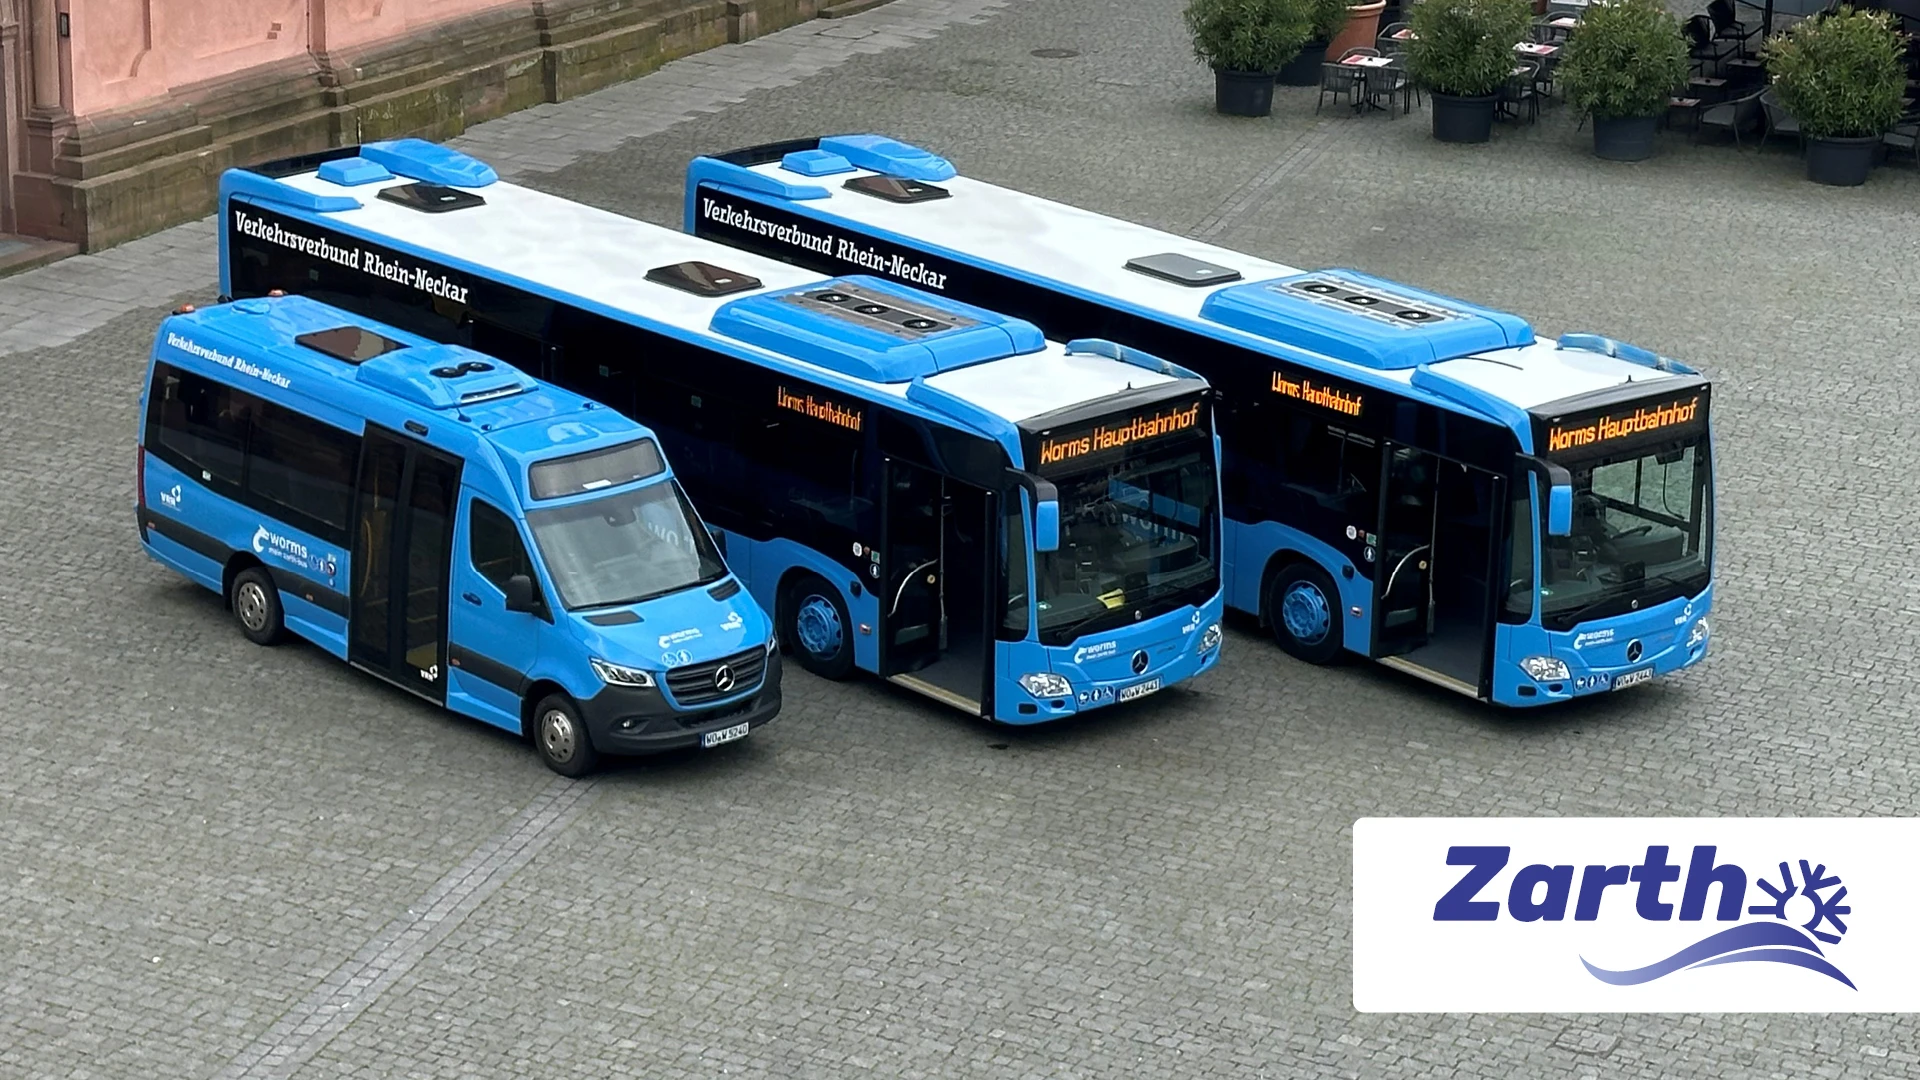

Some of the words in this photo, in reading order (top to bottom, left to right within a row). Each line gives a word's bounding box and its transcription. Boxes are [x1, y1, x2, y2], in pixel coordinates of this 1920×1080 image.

[235, 210, 359, 269] Verkehrsverbund
[364, 251, 468, 304] Rhein-Neckar
[703, 198, 832, 255] Verkehrsverbund
[836, 238, 947, 290] Rhein-Neckar
[167, 332, 235, 368] Verkehrsverbund
[234, 357, 291, 389] Rhein-Neckar
[1040, 436, 1089, 465] Worms
[1093, 402, 1200, 451] Hauptbahnhof
[1549, 426, 1595, 451] Worms
[1598, 396, 1698, 440] Hauptbahnhof
[269, 531, 307, 559] worms
